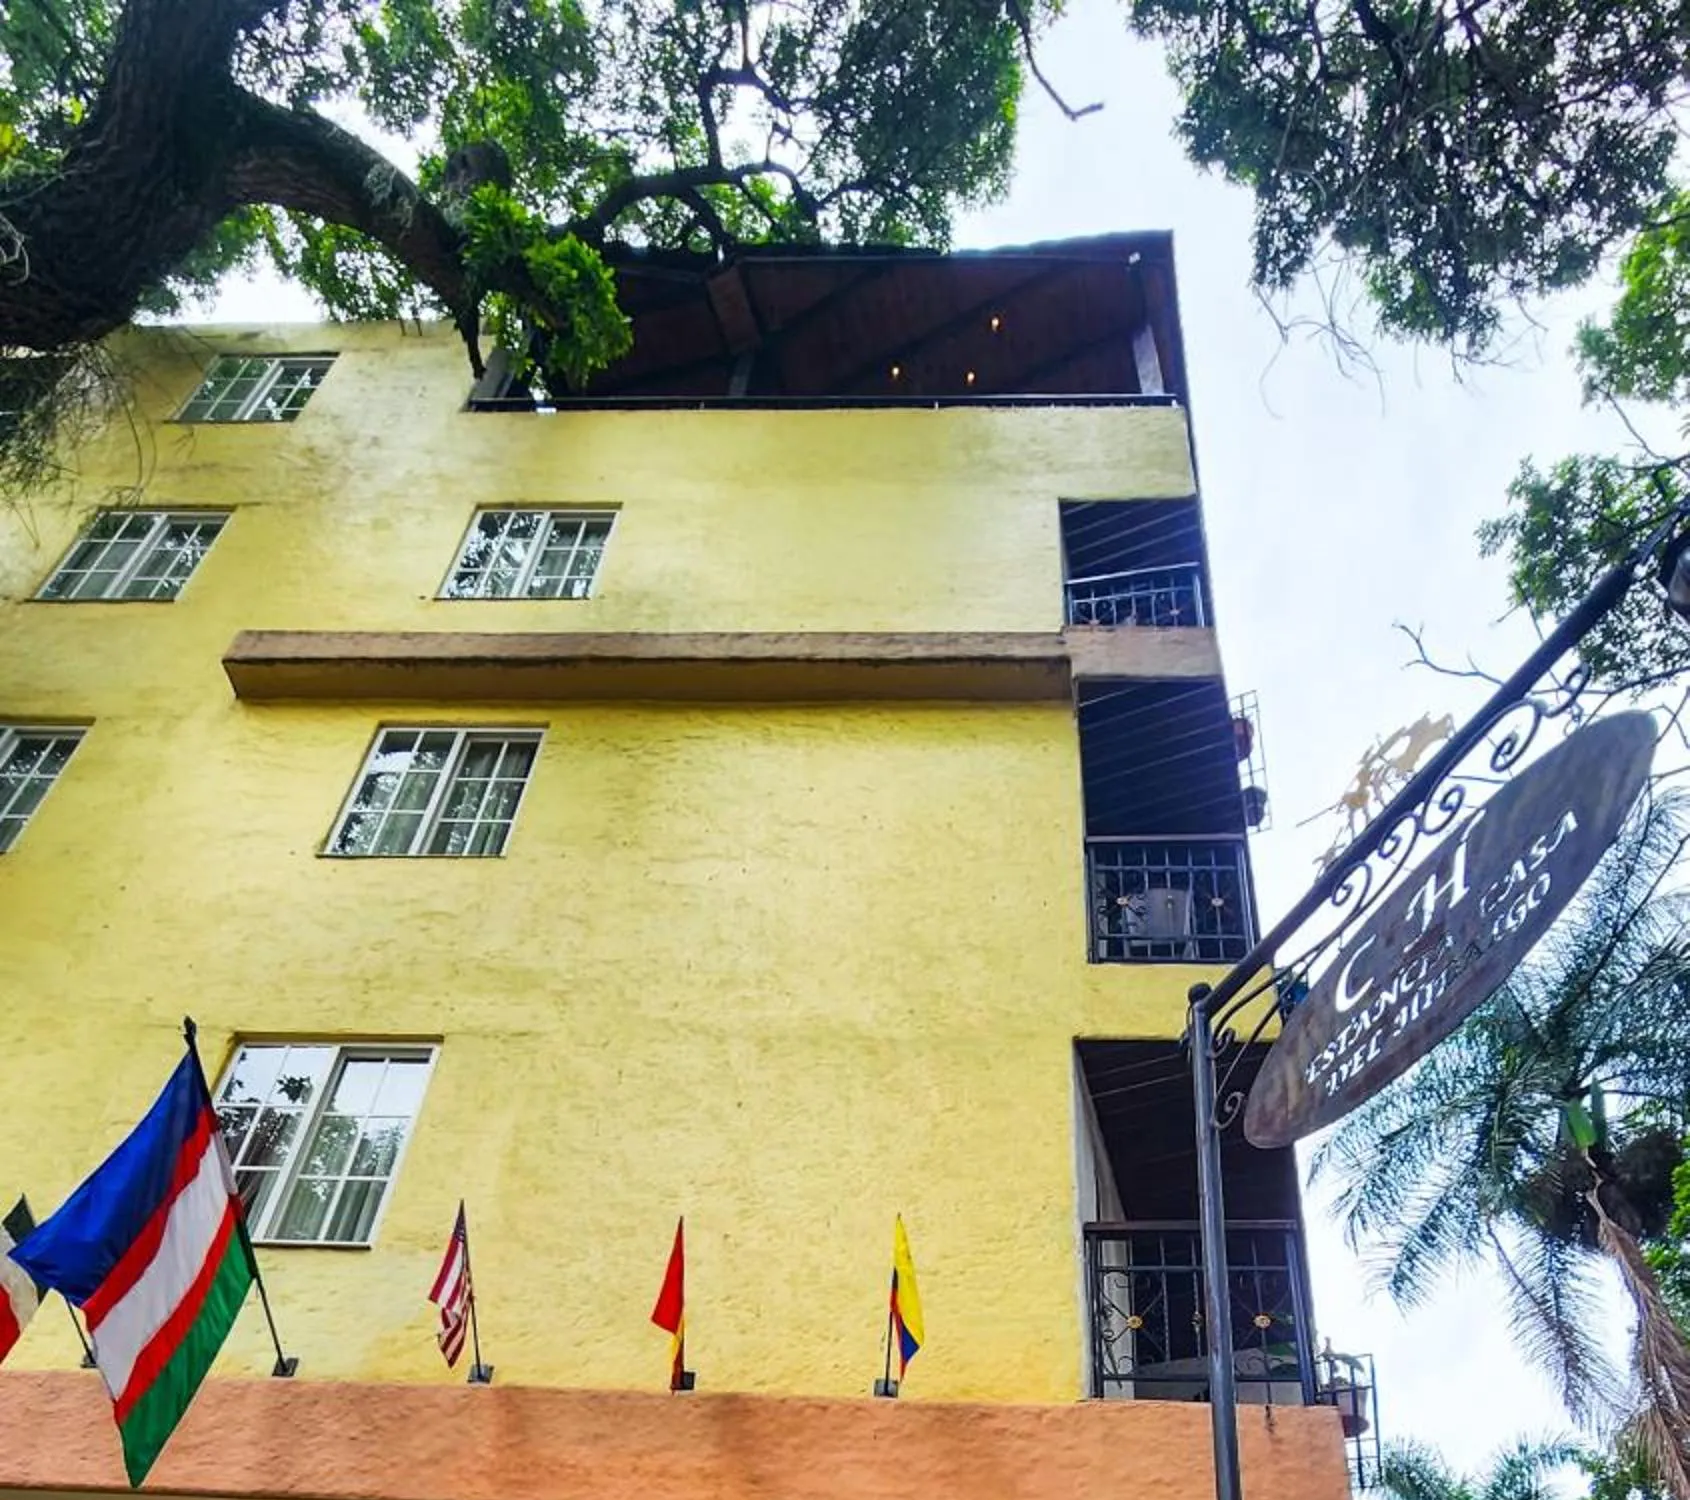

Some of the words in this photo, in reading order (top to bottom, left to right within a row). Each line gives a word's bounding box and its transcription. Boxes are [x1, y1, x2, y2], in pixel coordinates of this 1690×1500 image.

[1335, 934, 1377, 1012] C
[1403, 808, 1487, 953] H
[1479, 811, 1578, 918] CASA
